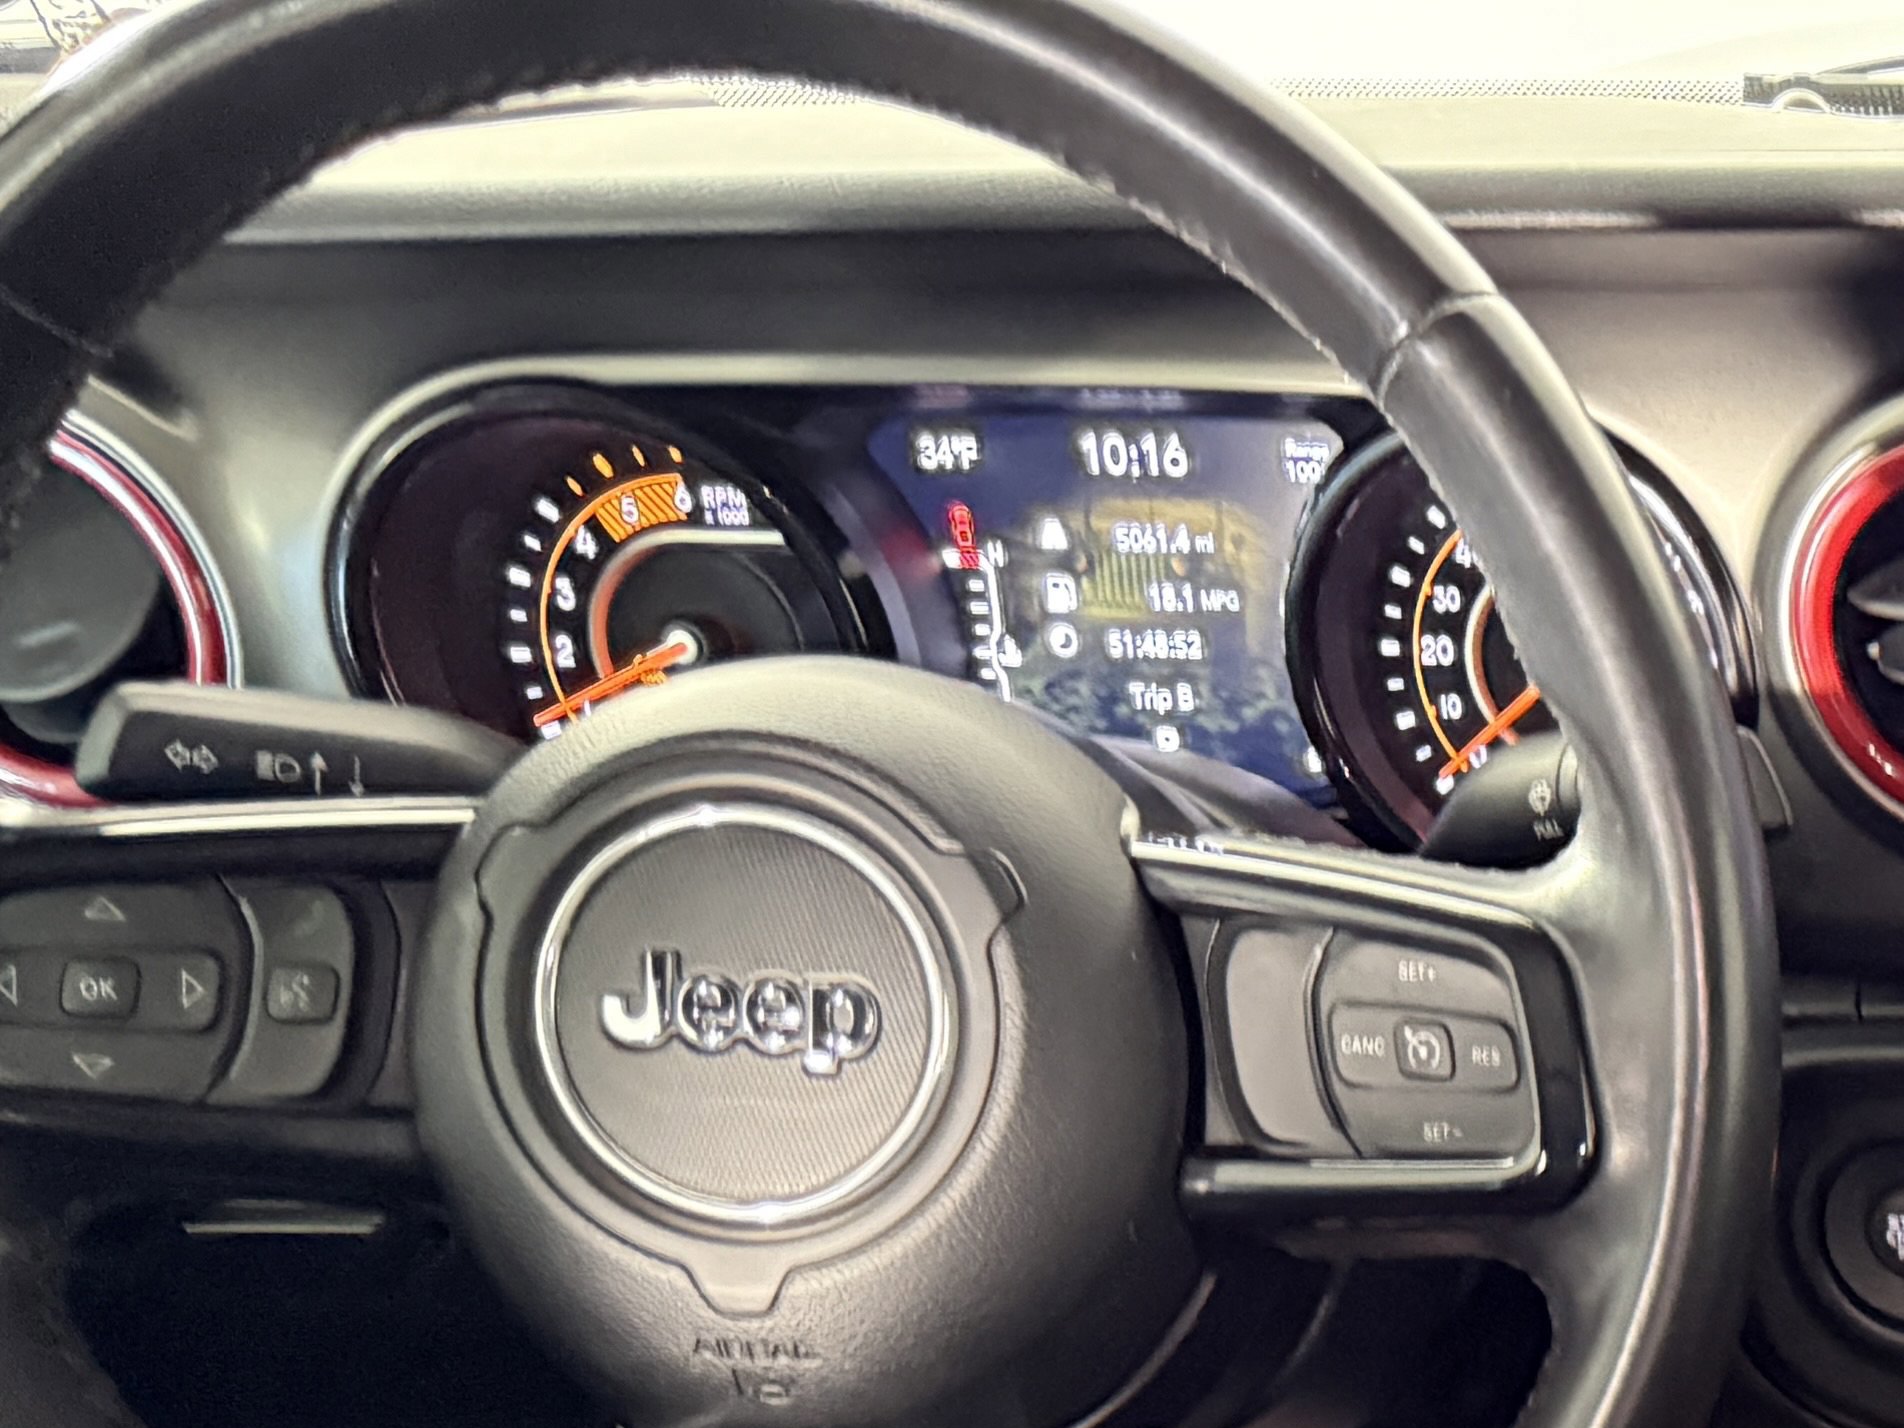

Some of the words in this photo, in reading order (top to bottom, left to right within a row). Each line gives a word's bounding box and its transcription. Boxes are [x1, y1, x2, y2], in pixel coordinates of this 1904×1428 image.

[1080, 430, 1188, 479] 10:16
[701, 484, 748, 509] RPM
[574, 525, 597, 560] 4
[555, 577, 577, 611] 3
[1200, 588, 1241, 613] MPG
[1433, 584, 1461, 614] 30
[555, 634, 577, 669] 2
[1420, 633, 1456, 666] 20
[1128, 683, 1174, 714] Trip
[1440, 693, 1462, 721] 10
[79, 975, 119, 1002] OK
[602, 943, 884, 1080] Jeep
